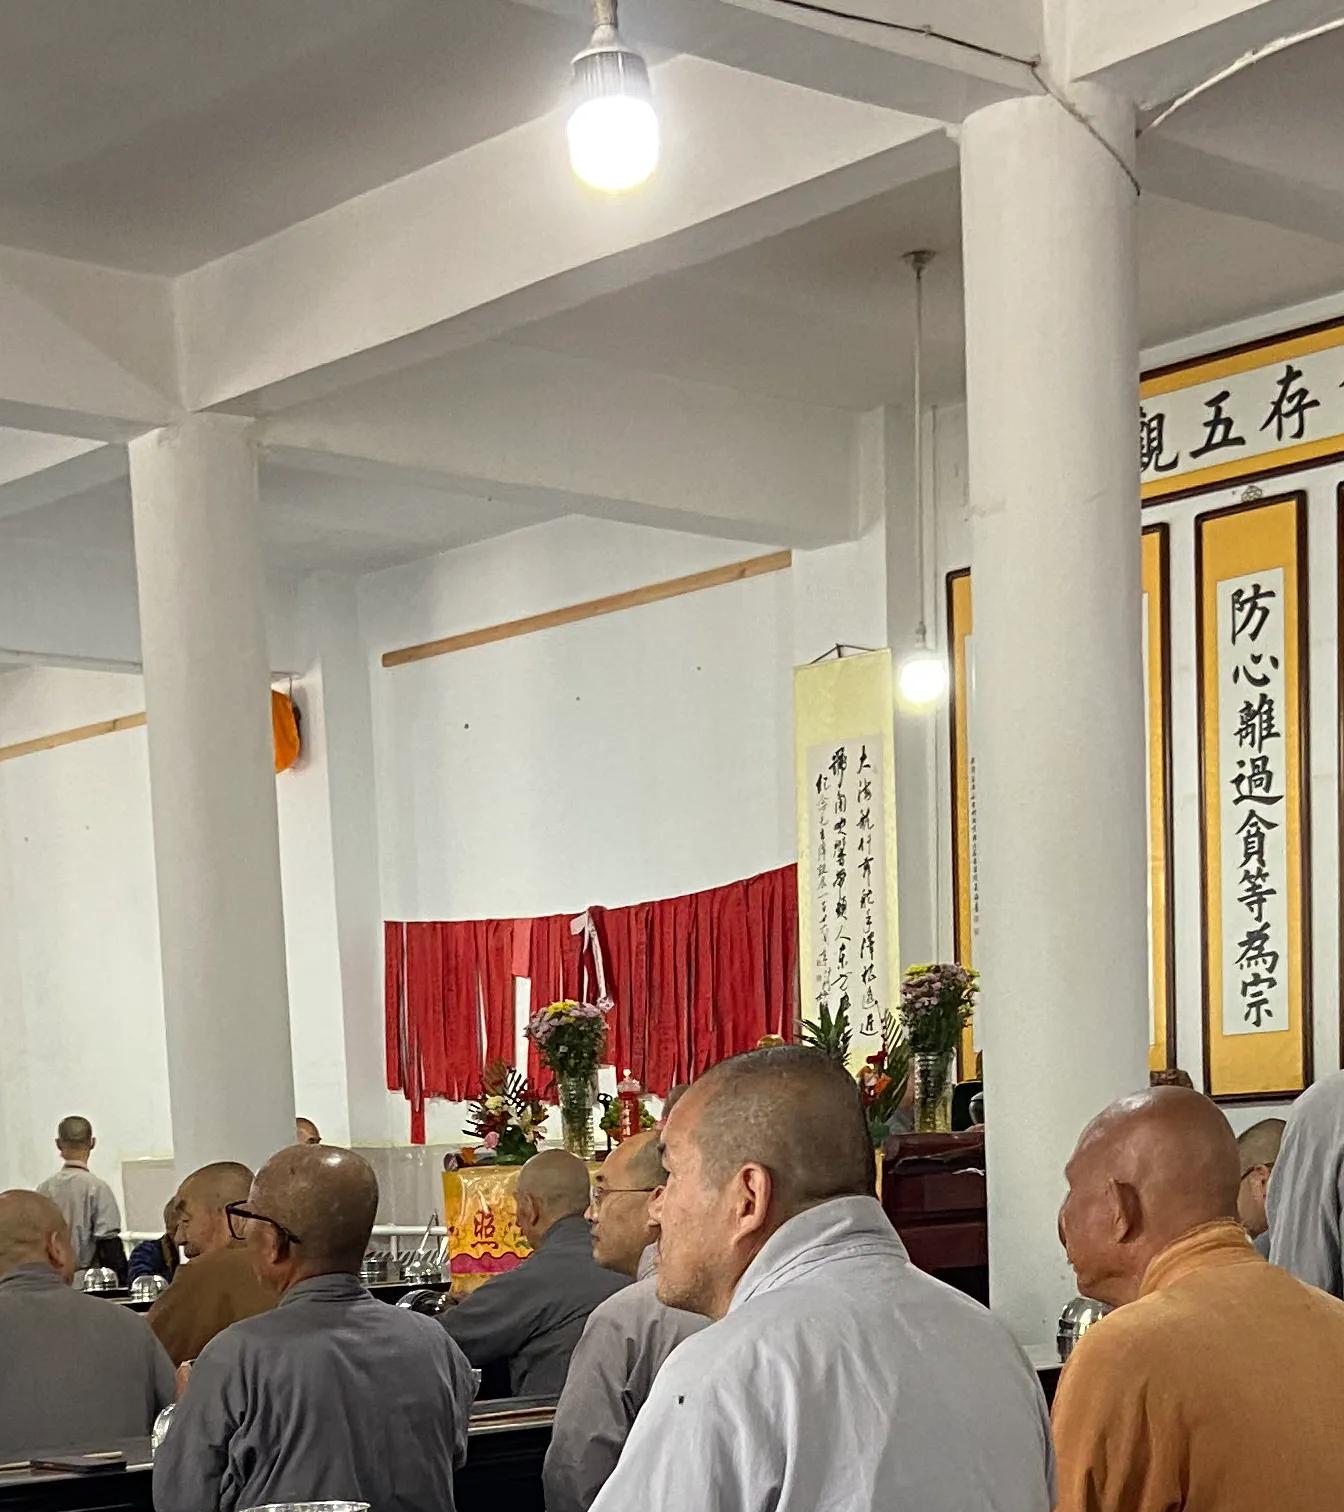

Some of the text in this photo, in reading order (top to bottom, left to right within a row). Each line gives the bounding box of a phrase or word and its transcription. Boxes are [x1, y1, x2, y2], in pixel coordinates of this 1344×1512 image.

[1229, 583, 1285, 1028] 防心離過貪等為宗
